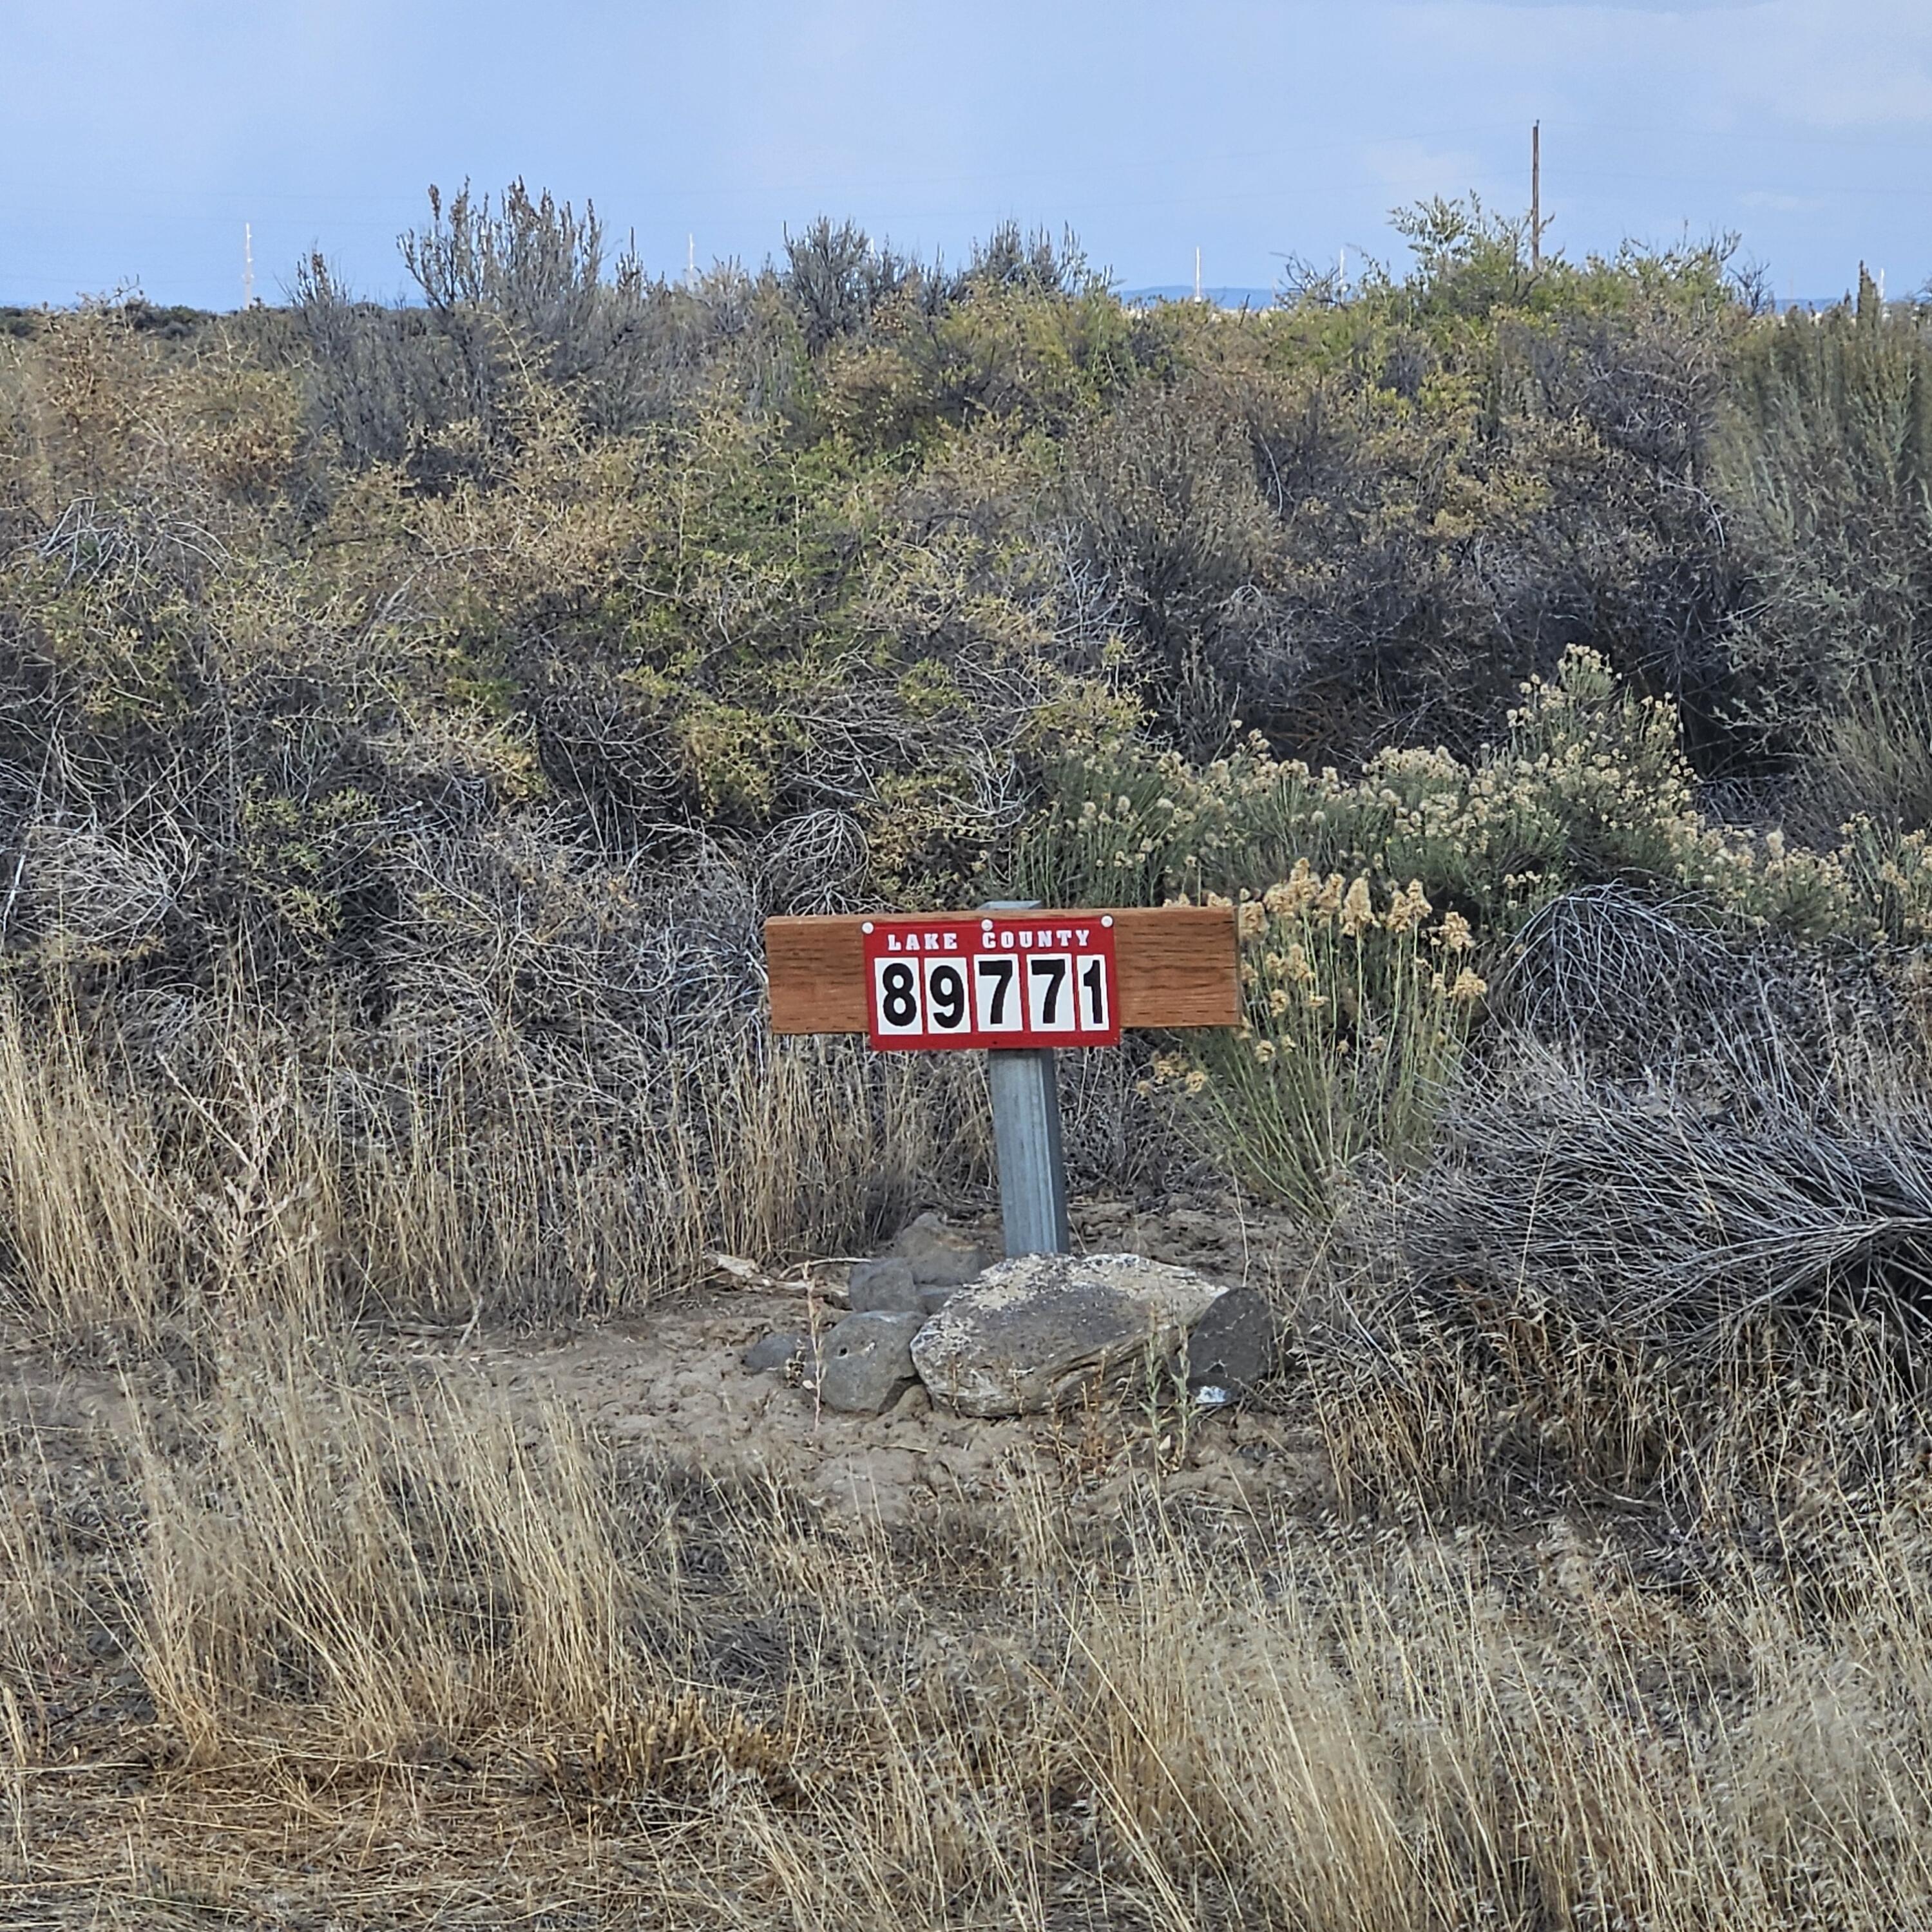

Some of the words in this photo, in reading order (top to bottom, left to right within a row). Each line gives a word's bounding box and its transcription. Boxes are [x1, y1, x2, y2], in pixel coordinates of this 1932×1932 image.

[887, 933, 958, 951] LAKE
[982, 930, 1090, 948] COUNTY
[881, 959, 1104, 1029] 89771
